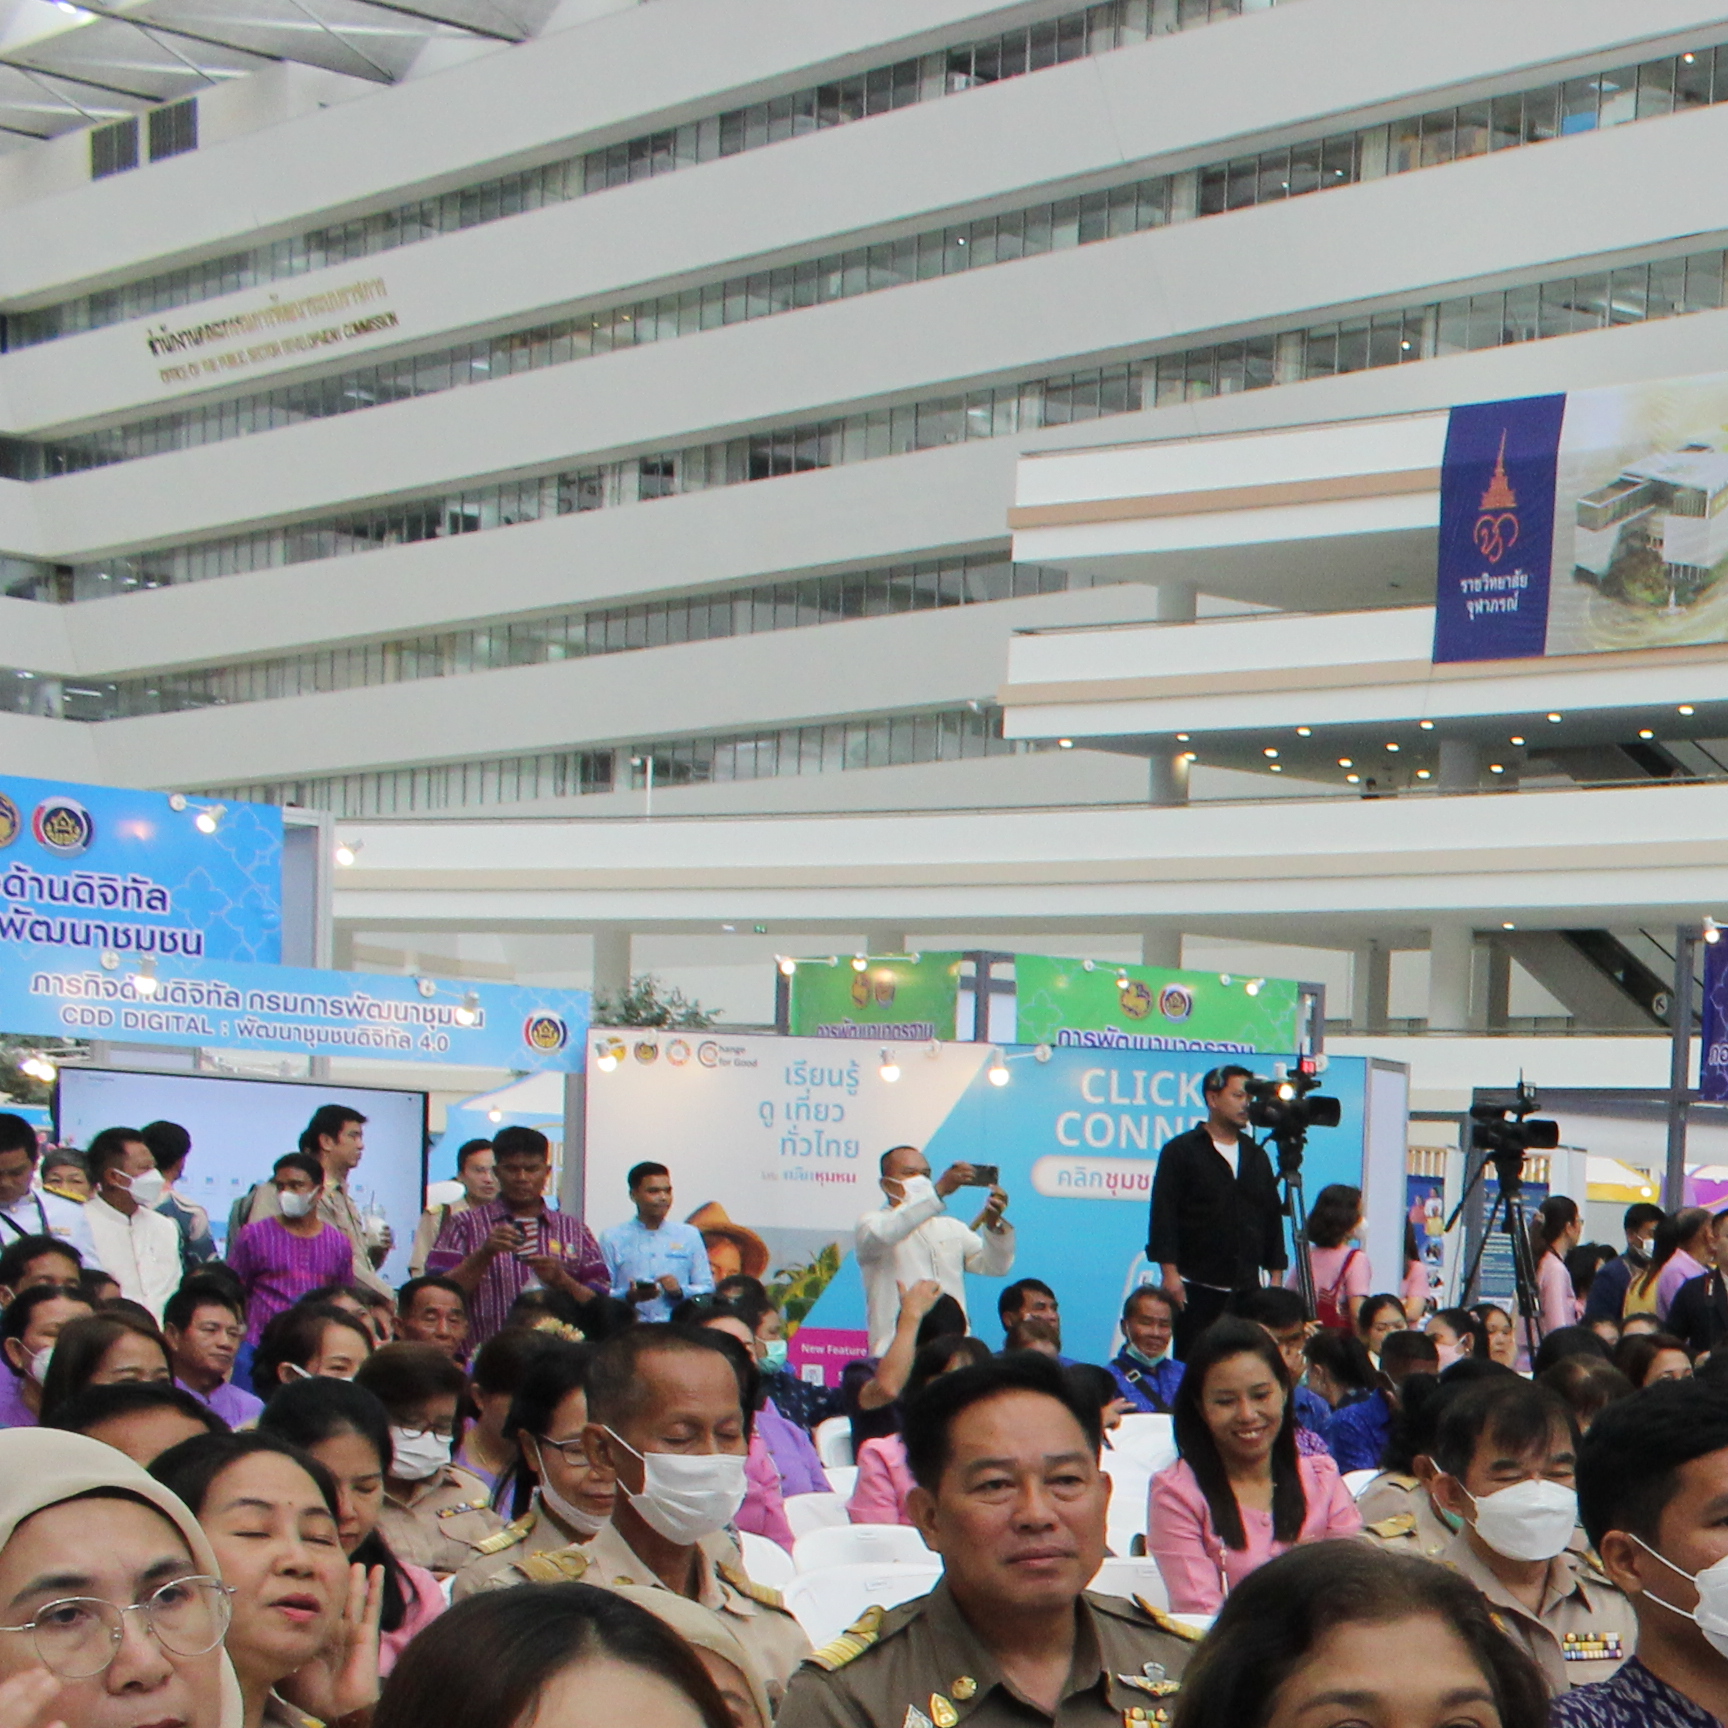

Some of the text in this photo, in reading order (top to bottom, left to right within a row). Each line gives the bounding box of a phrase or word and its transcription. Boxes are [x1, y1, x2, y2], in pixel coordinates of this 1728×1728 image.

[31, 971, 241, 1010] ภารกิจด้นดิจิทัล
[61, 1004, 114, 1028] CDD
[122, 1011, 214, 1036] DIGITAL
[419, 1033, 449, 1052] 4.0
[784, 1059, 861, 1096] เรียนรู้
[1080, 1067, 1205, 1107] CLICK
[758, 1088, 845, 1128] ดู เที่ยว
[780, 1124, 860, 1159] ทั่วไทย
[801, 1343, 867, 1357] New Feature
